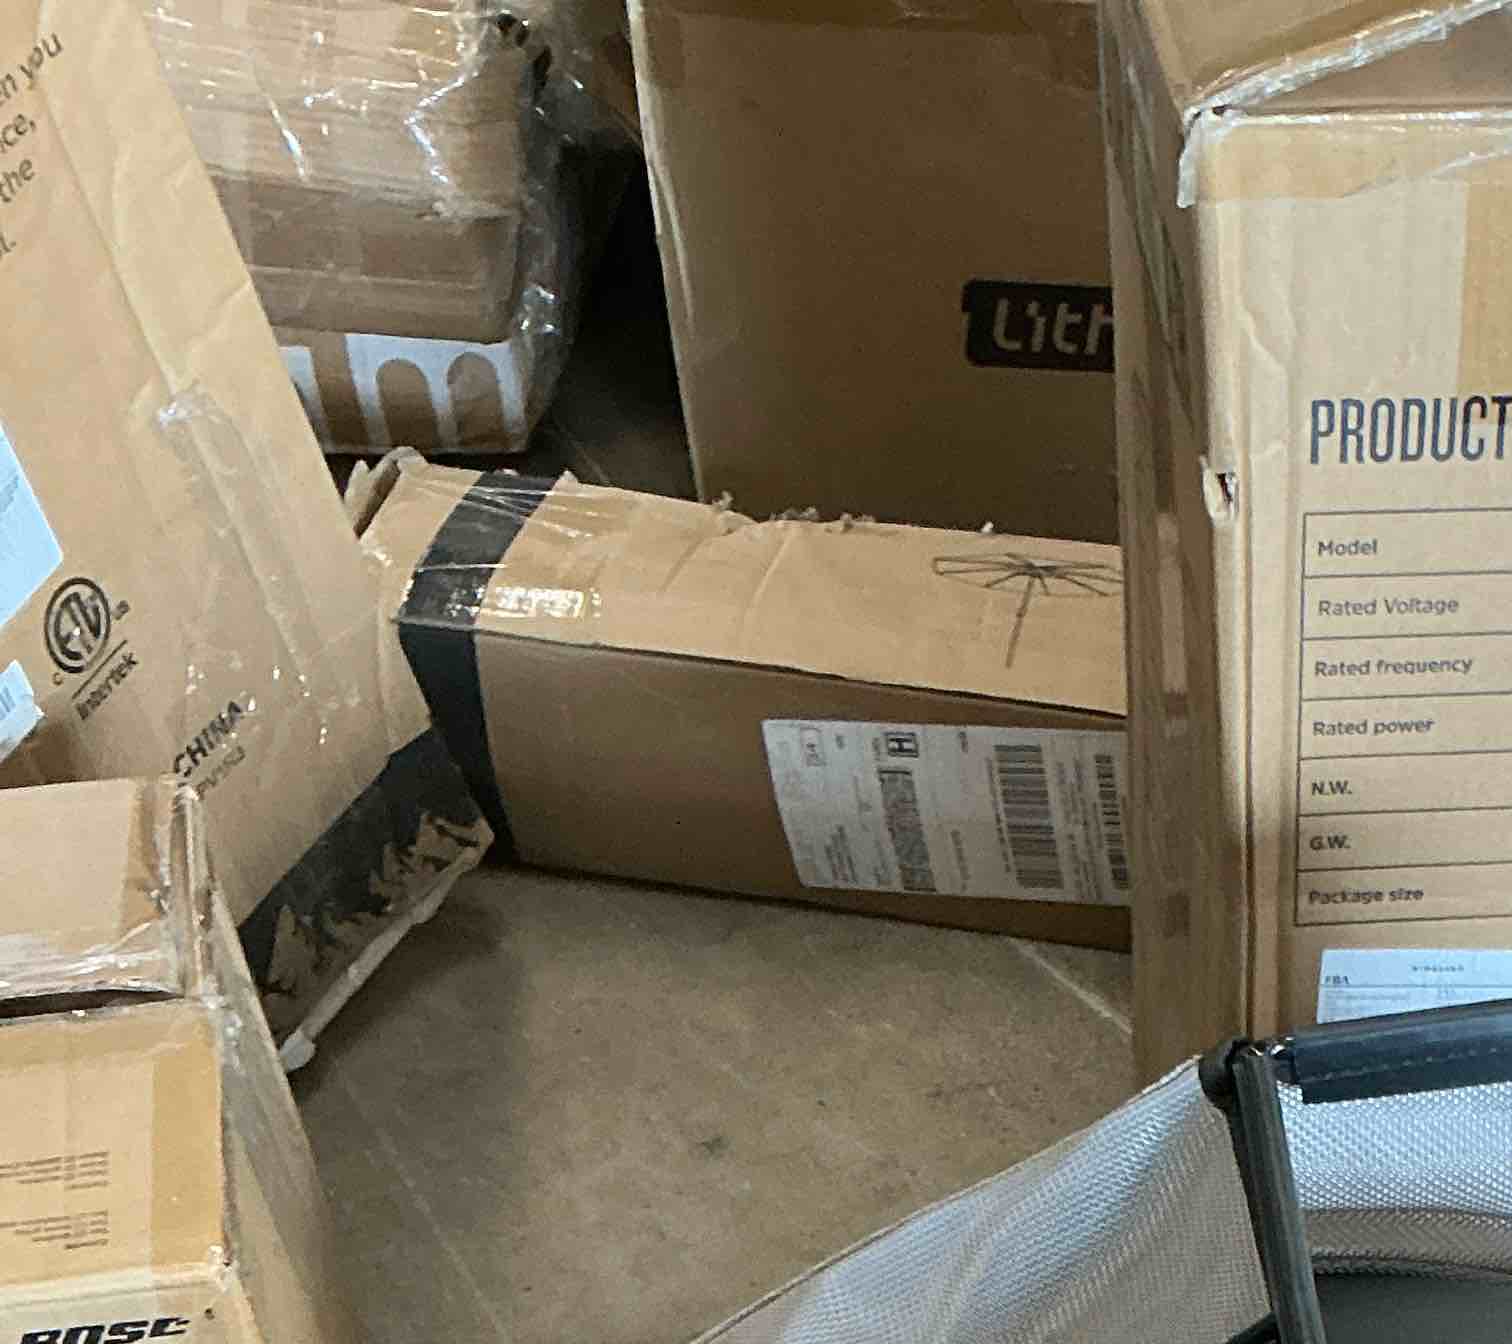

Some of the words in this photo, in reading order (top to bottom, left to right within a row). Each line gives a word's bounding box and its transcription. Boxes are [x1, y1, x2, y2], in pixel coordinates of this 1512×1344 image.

[20, 33, 63, 90] you
[1317, 538, 1378, 557] Model
[1318, 599, 1377, 617] Rated
[1383, 597, 1460, 617] Voltage
[1314, 660, 1371, 677] Rated
[1376, 657, 1474, 677] frequency
[1312, 719, 1369, 736] Rated
[1373, 718, 1436, 737] power
[1310, 780, 1353, 796] N.W.
[1309, 834, 1352, 851] G.W.
[1308, 889, 1385, 908] Package
[1387, 886, 1425, 902] size
